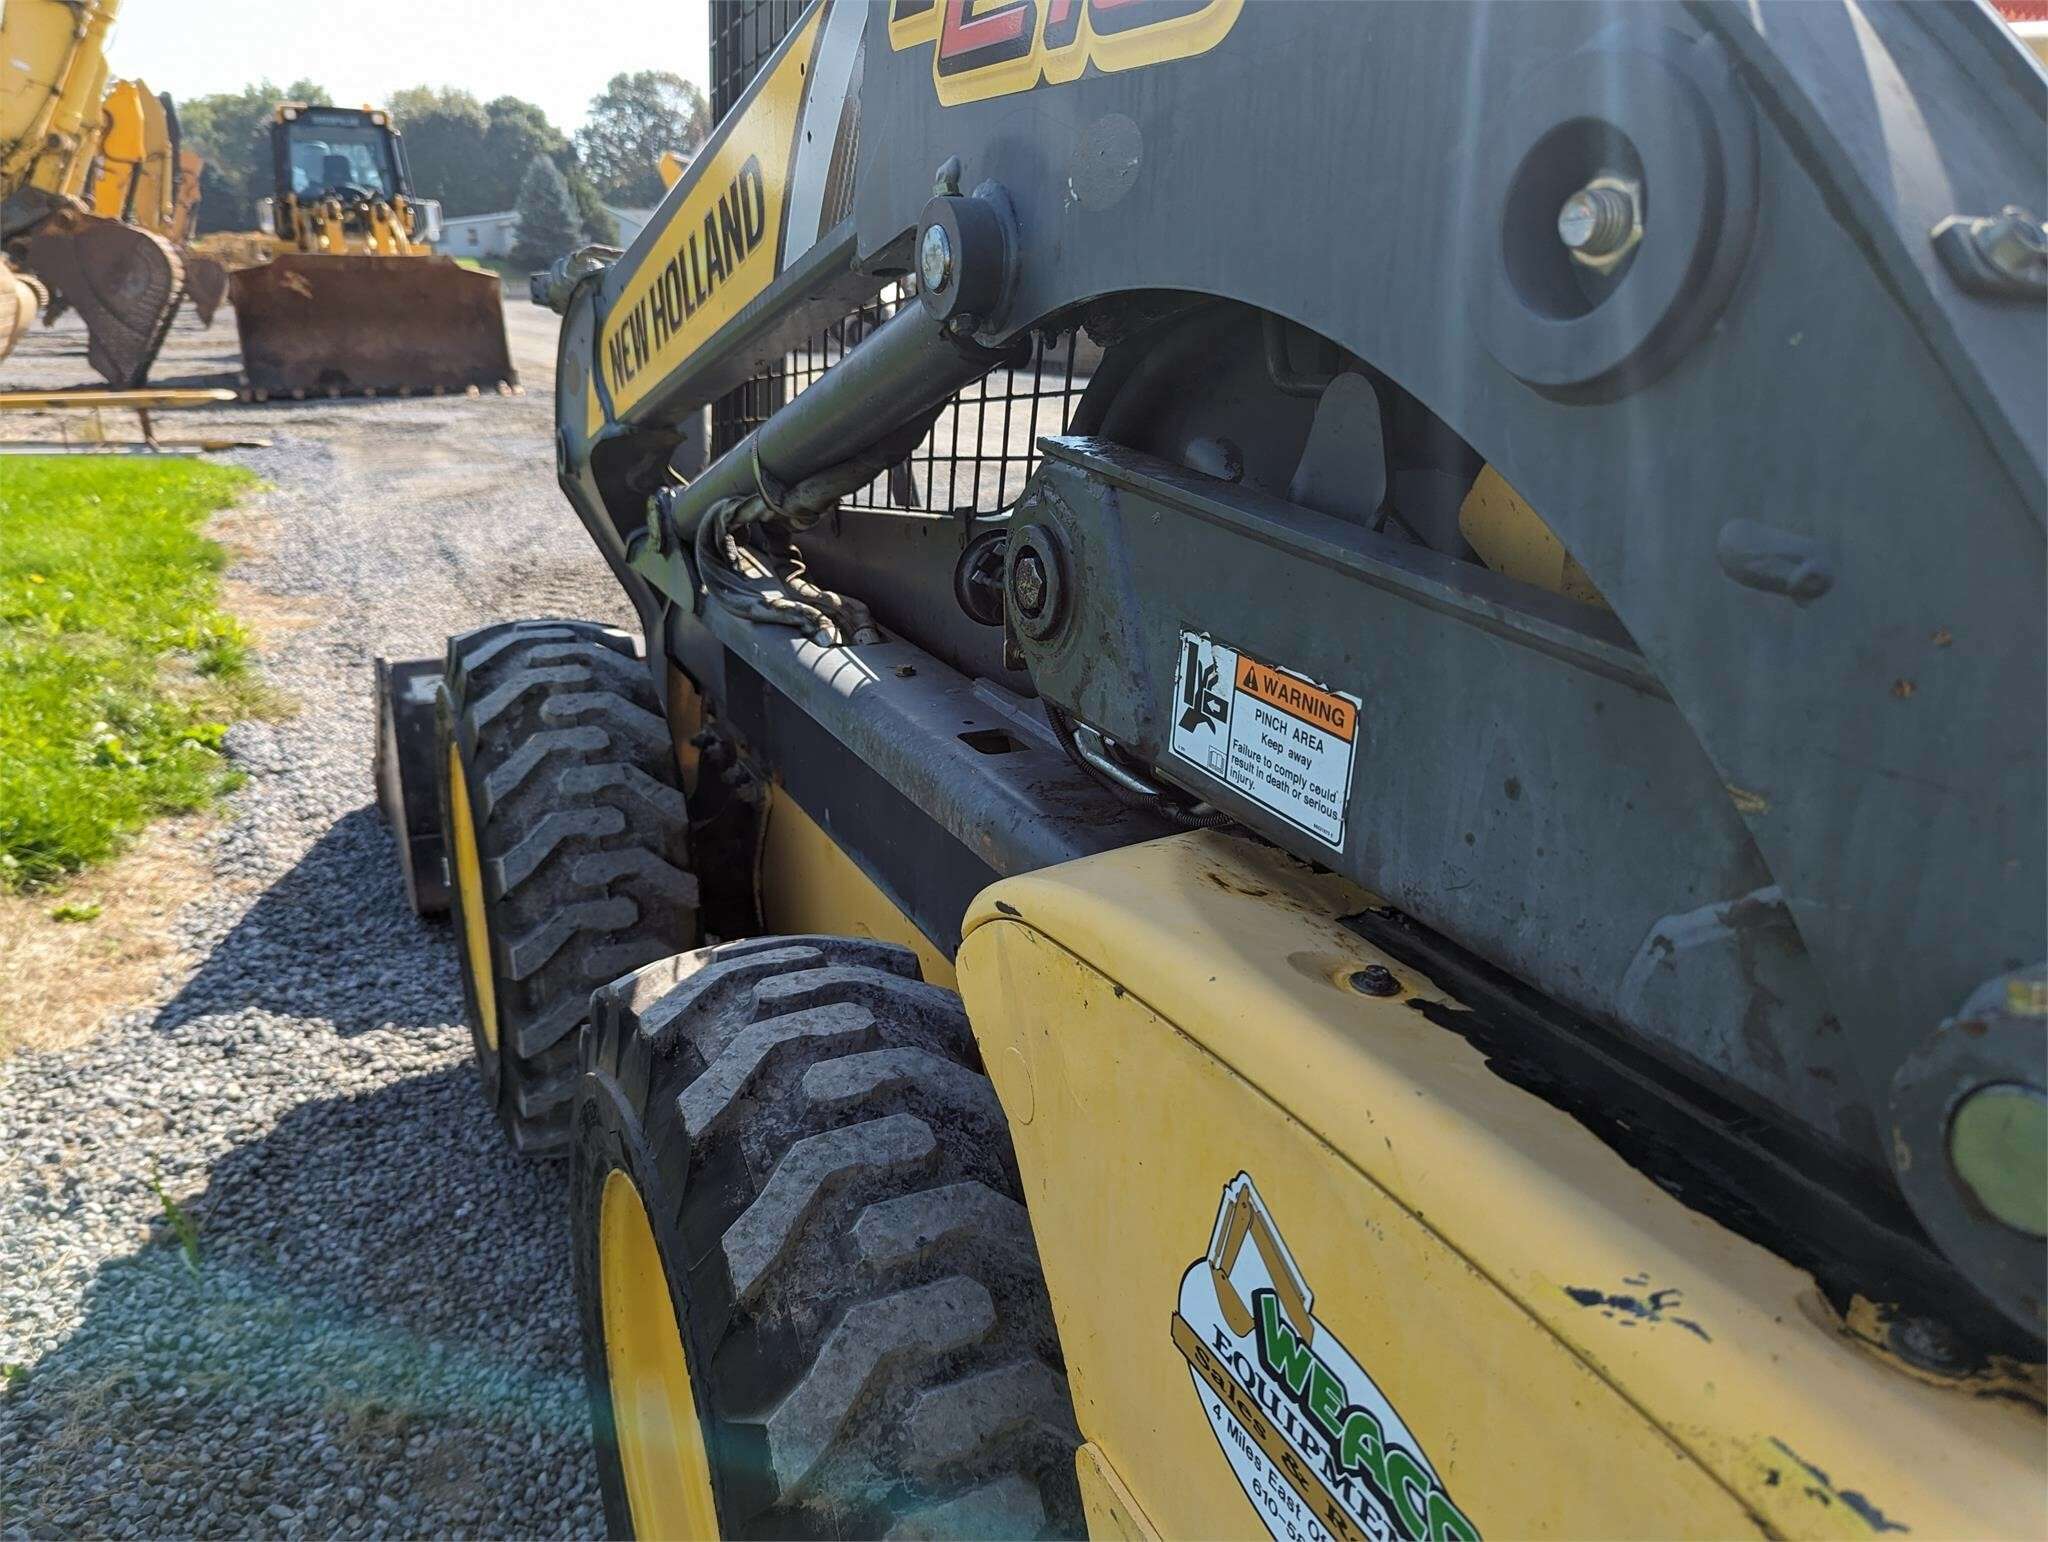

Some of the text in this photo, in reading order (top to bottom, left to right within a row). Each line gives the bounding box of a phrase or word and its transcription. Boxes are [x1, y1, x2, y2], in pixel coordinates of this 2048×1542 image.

[608, 153, 765, 394] NEW HOLLAND
[1255, 708, 1324, 754] PINCH AREA
[1263, 675, 1345, 728] WARNING
[1230, 766, 1255, 791] injury.
[1232, 738, 1337, 803] Failure to comply could
[1261, 732, 1312, 770] Keep away
[1231, 755, 1338, 820] result in death or serious
[1195, 1345, 1357, 1542] Sales & R
[1212, 1403, 1222, 1421] 4
[1227, 1418, 1263, 1472] Miles
[1268, 1467, 1302, 1522] East
